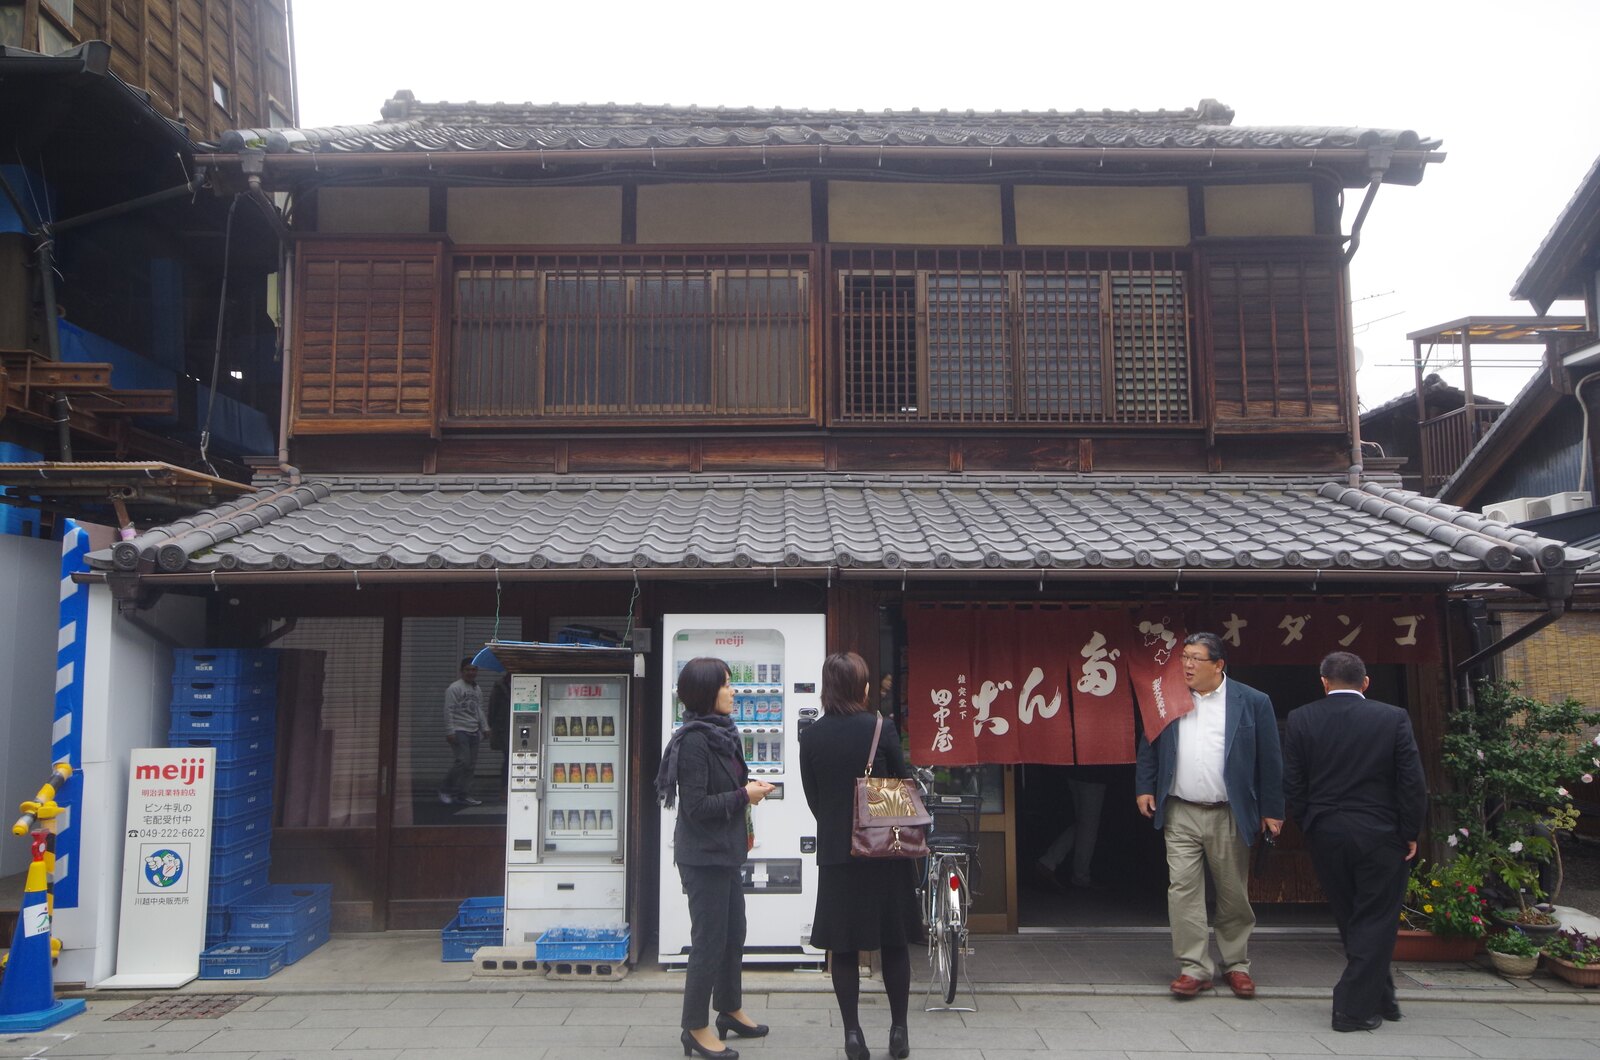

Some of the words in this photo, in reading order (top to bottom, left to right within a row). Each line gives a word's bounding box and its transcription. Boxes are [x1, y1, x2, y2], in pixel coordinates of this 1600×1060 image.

[715, 635, 744, 647] meiji
[930, 689, 953, 752] 田中屋
[135, 758, 205, 785] meiji
[141, 789, 196, 797] 明治乳業特約店
[144, 803, 192, 813] ビン牛乳の
[143, 815, 192, 825] 宅配受付中
[139, 829, 205, 838] 049-222-6622
[134, 897, 190, 905] 川越中央販売所
